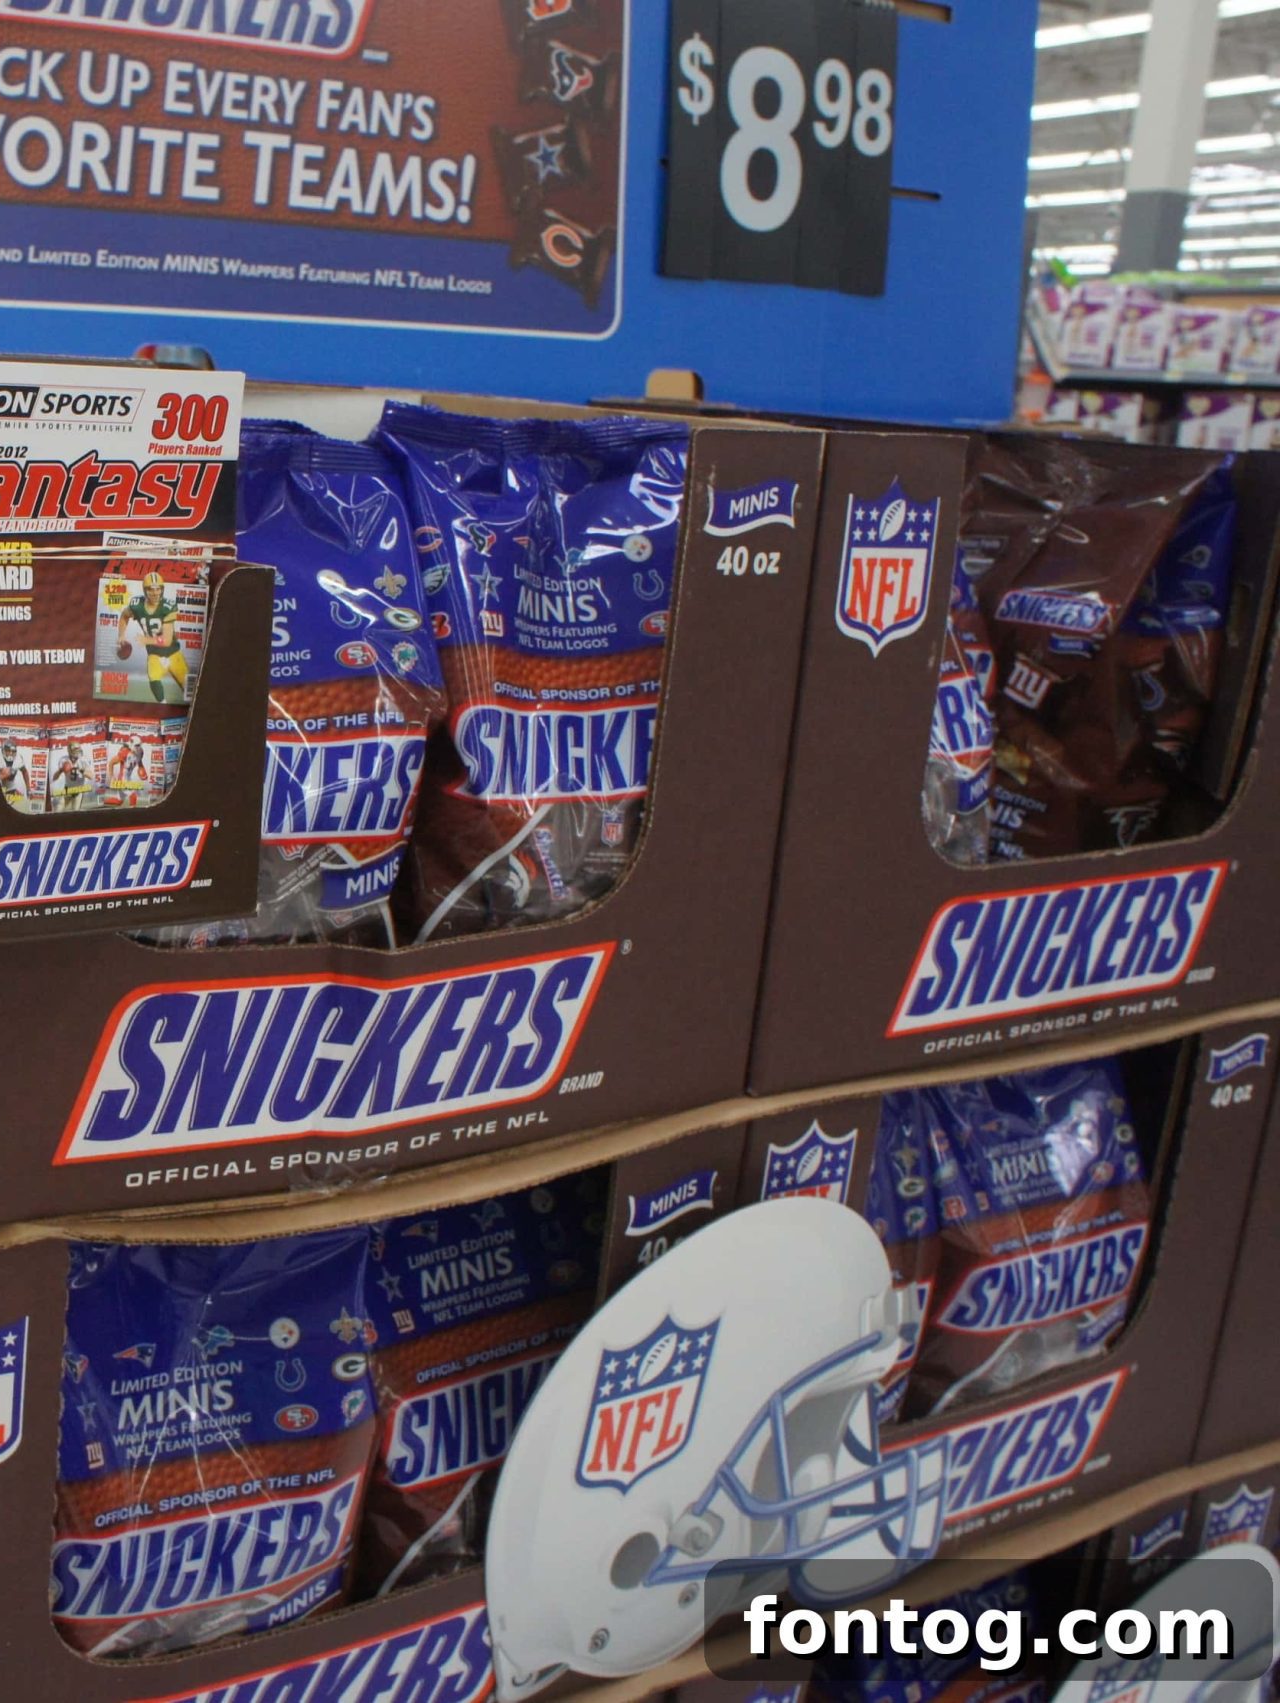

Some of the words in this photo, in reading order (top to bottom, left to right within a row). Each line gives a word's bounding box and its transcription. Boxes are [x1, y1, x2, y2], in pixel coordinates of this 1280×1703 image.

[77, 50, 150, 108] UP
[163, 61, 307, 125] EVERY
[317, 79, 435, 141] FAN'S
[243, 131, 477, 224] TEAMS!
[28, 246, 92, 267] LIMITED
[96, 249, 160, 271] EDITION
[163, 253, 219, 275] MINIS
[223, 258, 295, 280] WRAPPERS
[299, 263, 370, 286] FEATURING
[373, 268, 405, 287] NFL
[409, 271, 445, 291] TEAM
[448, 274, 493, 295] LOGOS
[41, 393, 134, 416] SPORTS
[151, 393, 228, 443] 300
[35, 422, 72, 432] SPORTS
[79, 423, 134, 433] PUBLISHER
[148, 442, 183, 458] Players
[186, 443, 223, 457] Ranked
[729, 487, 780, 520] MINIS
[716, 546, 749, 576] 40
[753, 552, 781, 575] oz
[544, 577, 602, 591] EDITION
[846, 557, 918, 631] NFL
[517, 586, 598, 623] MINIS
[535, 637, 564, 650] TEAM
[567, 637, 609, 650] LOGOS
[552, 624, 617, 638] FEATURING
[10, 650, 42, 665] YOUR
[43, 648, 86, 664] TEBOW
[51, 701, 77, 714] MORE
[494, 683, 536, 700] OFFICIAL
[540, 688, 610, 700] SPONSOR
[616, 684, 635, 696] OF
[304, 718, 326, 730] OF
[333, 713, 367, 728] THE
[374, 711, 404, 724] NFL
[265, 739, 426, 834] KERS
[190, 878, 213, 888] BRAND
[346, 857, 400, 899] MINIS
[45, 902, 103, 916] SPONSOR
[107, 900, 122, 909] OF
[126, 896, 149, 906] THE
[153, 894, 174, 904] NFL
[905, 868, 1214, 1017] SNICKERS
[923, 1031, 1003, 1054] OFFICIAL
[1010, 1013, 1087, 1038] SPONSOR
[1092, 1008, 1113, 1022] OF
[1119, 1001, 1147, 1017] THE
[1152, 996, 1180, 1012] NFL
[84, 956, 594, 1142] SNICKERS
[558, 1071, 605, 1096] BRAND
[1219, 1047, 1256, 1071] MINIS
[1211, 1086, 1231, 1108] 40
[126, 1160, 257, 1189] OFFICIAL
[270, 1141, 399, 1171] SPONSOR
[409, 1132, 443, 1150] OF
[451, 1120, 498, 1142] THE
[506, 1108, 550, 1131] NFL
[649, 1179, 698, 1218] MINIS
[407, 1246, 459, 1270] LIMITED
[461, 1228, 516, 1250] EDITION
[420, 1247, 514, 1299] MINIS
[949, 1228, 1146, 1328] SNICKERS
[433, 1312, 455, 1325] NFL
[456, 1302, 485, 1318] TEAM
[111, 1371, 169, 1396] LIMITED
[173, 1360, 243, 1384] EDITION
[417, 1364, 463, 1384] OFFICIAL
[466, 1340, 528, 1368] SPONSOR
[118, 1380, 234, 1430] MINIS
[113, 1426, 179, 1448] WRAPPERS
[180, 1412, 252, 1433] FEATURING
[155, 1436, 195, 1455] TEAM
[196, 1429, 241, 1445] LOGOS
[587, 1385, 685, 1473] NFL
[94, 1505, 153, 1528] OFFICIAL
[159, 1488, 237, 1513] SPONSOR
[241, 1480, 265, 1496] OF
[267, 1474, 302, 1491] THE
[307, 1468, 336, 1486] NFL
[53, 1481, 349, 1615] SNICKERS
[268, 1579, 327, 1627] MINIS
